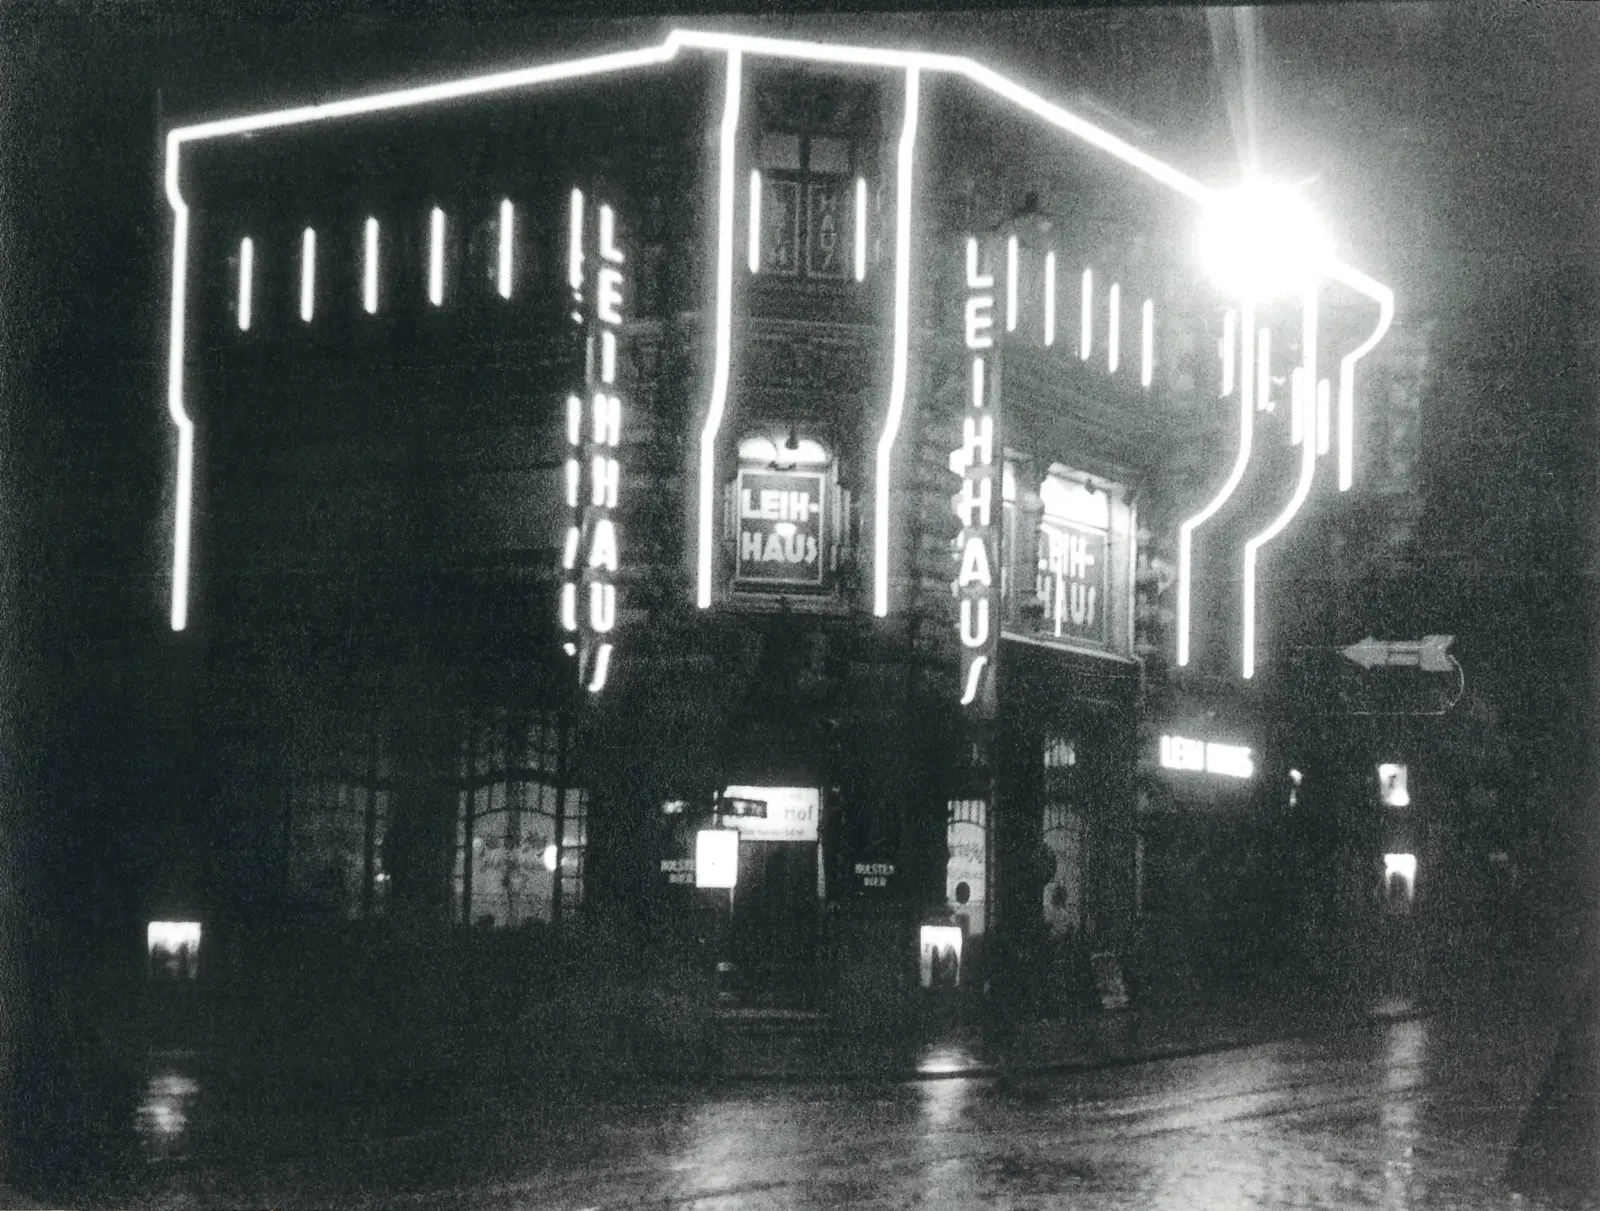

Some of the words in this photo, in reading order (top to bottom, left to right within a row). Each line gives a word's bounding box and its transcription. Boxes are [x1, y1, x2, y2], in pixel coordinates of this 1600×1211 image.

[589, 203, 625, 692] LEIHHAUS
[742, 488, 819, 522] LEIH-
[742, 531, 818, 564] HAUS
[960, 236, 994, 705] LEIHHAUS
